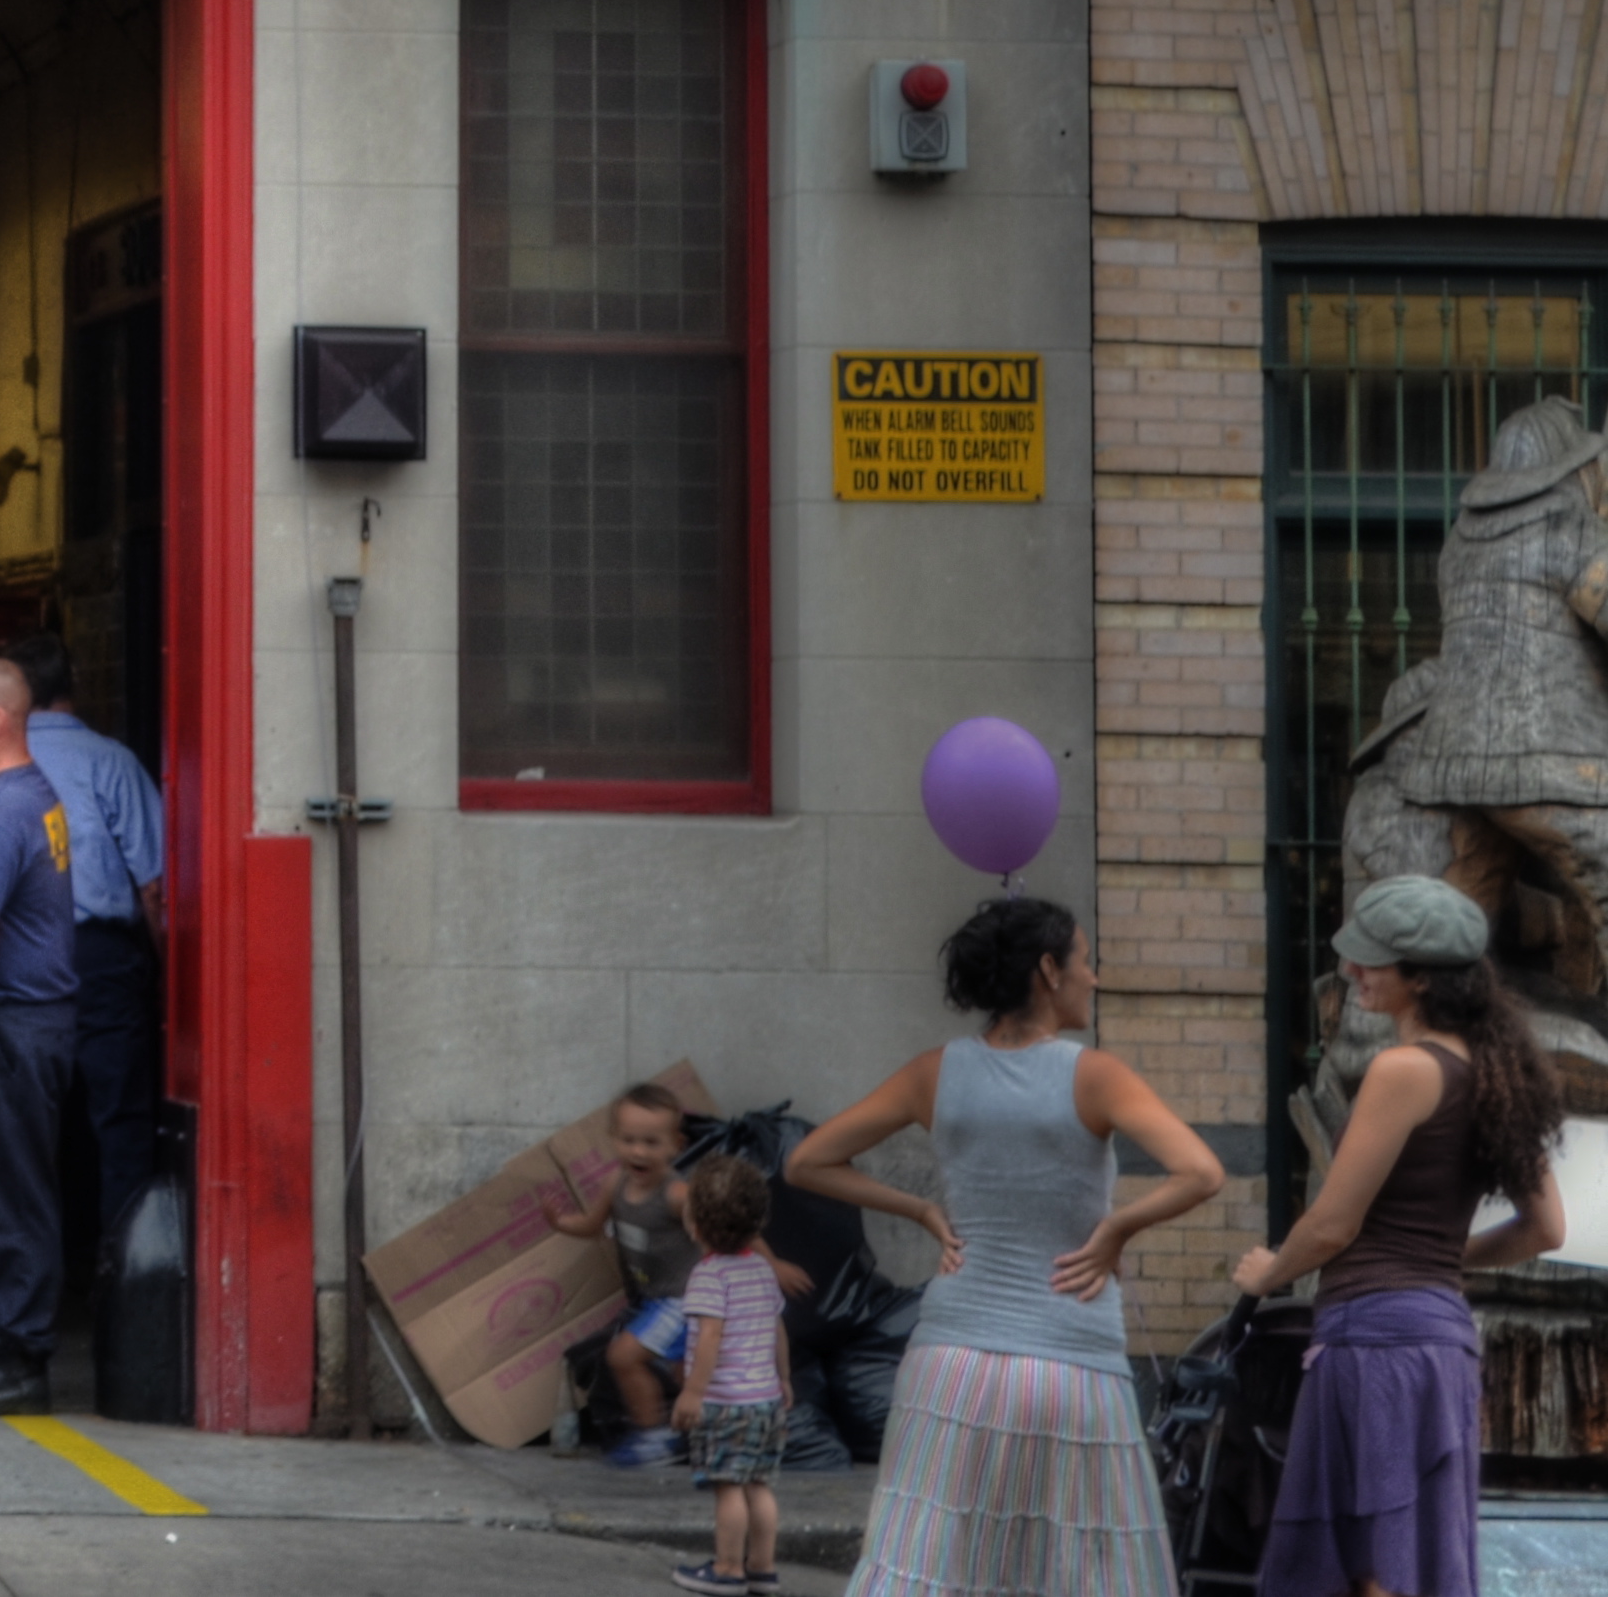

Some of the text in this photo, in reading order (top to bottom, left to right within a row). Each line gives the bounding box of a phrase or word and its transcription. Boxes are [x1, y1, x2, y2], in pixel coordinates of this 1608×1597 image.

[844, 359, 1030, 399] CAUTION
[842, 408, 1035, 433] WHEN ALARM BELL SOUNDS
[847, 437, 1031, 462] TANK FILLED TO CAPACITY
[853, 469, 1029, 493] DO NOT OVERFILL
